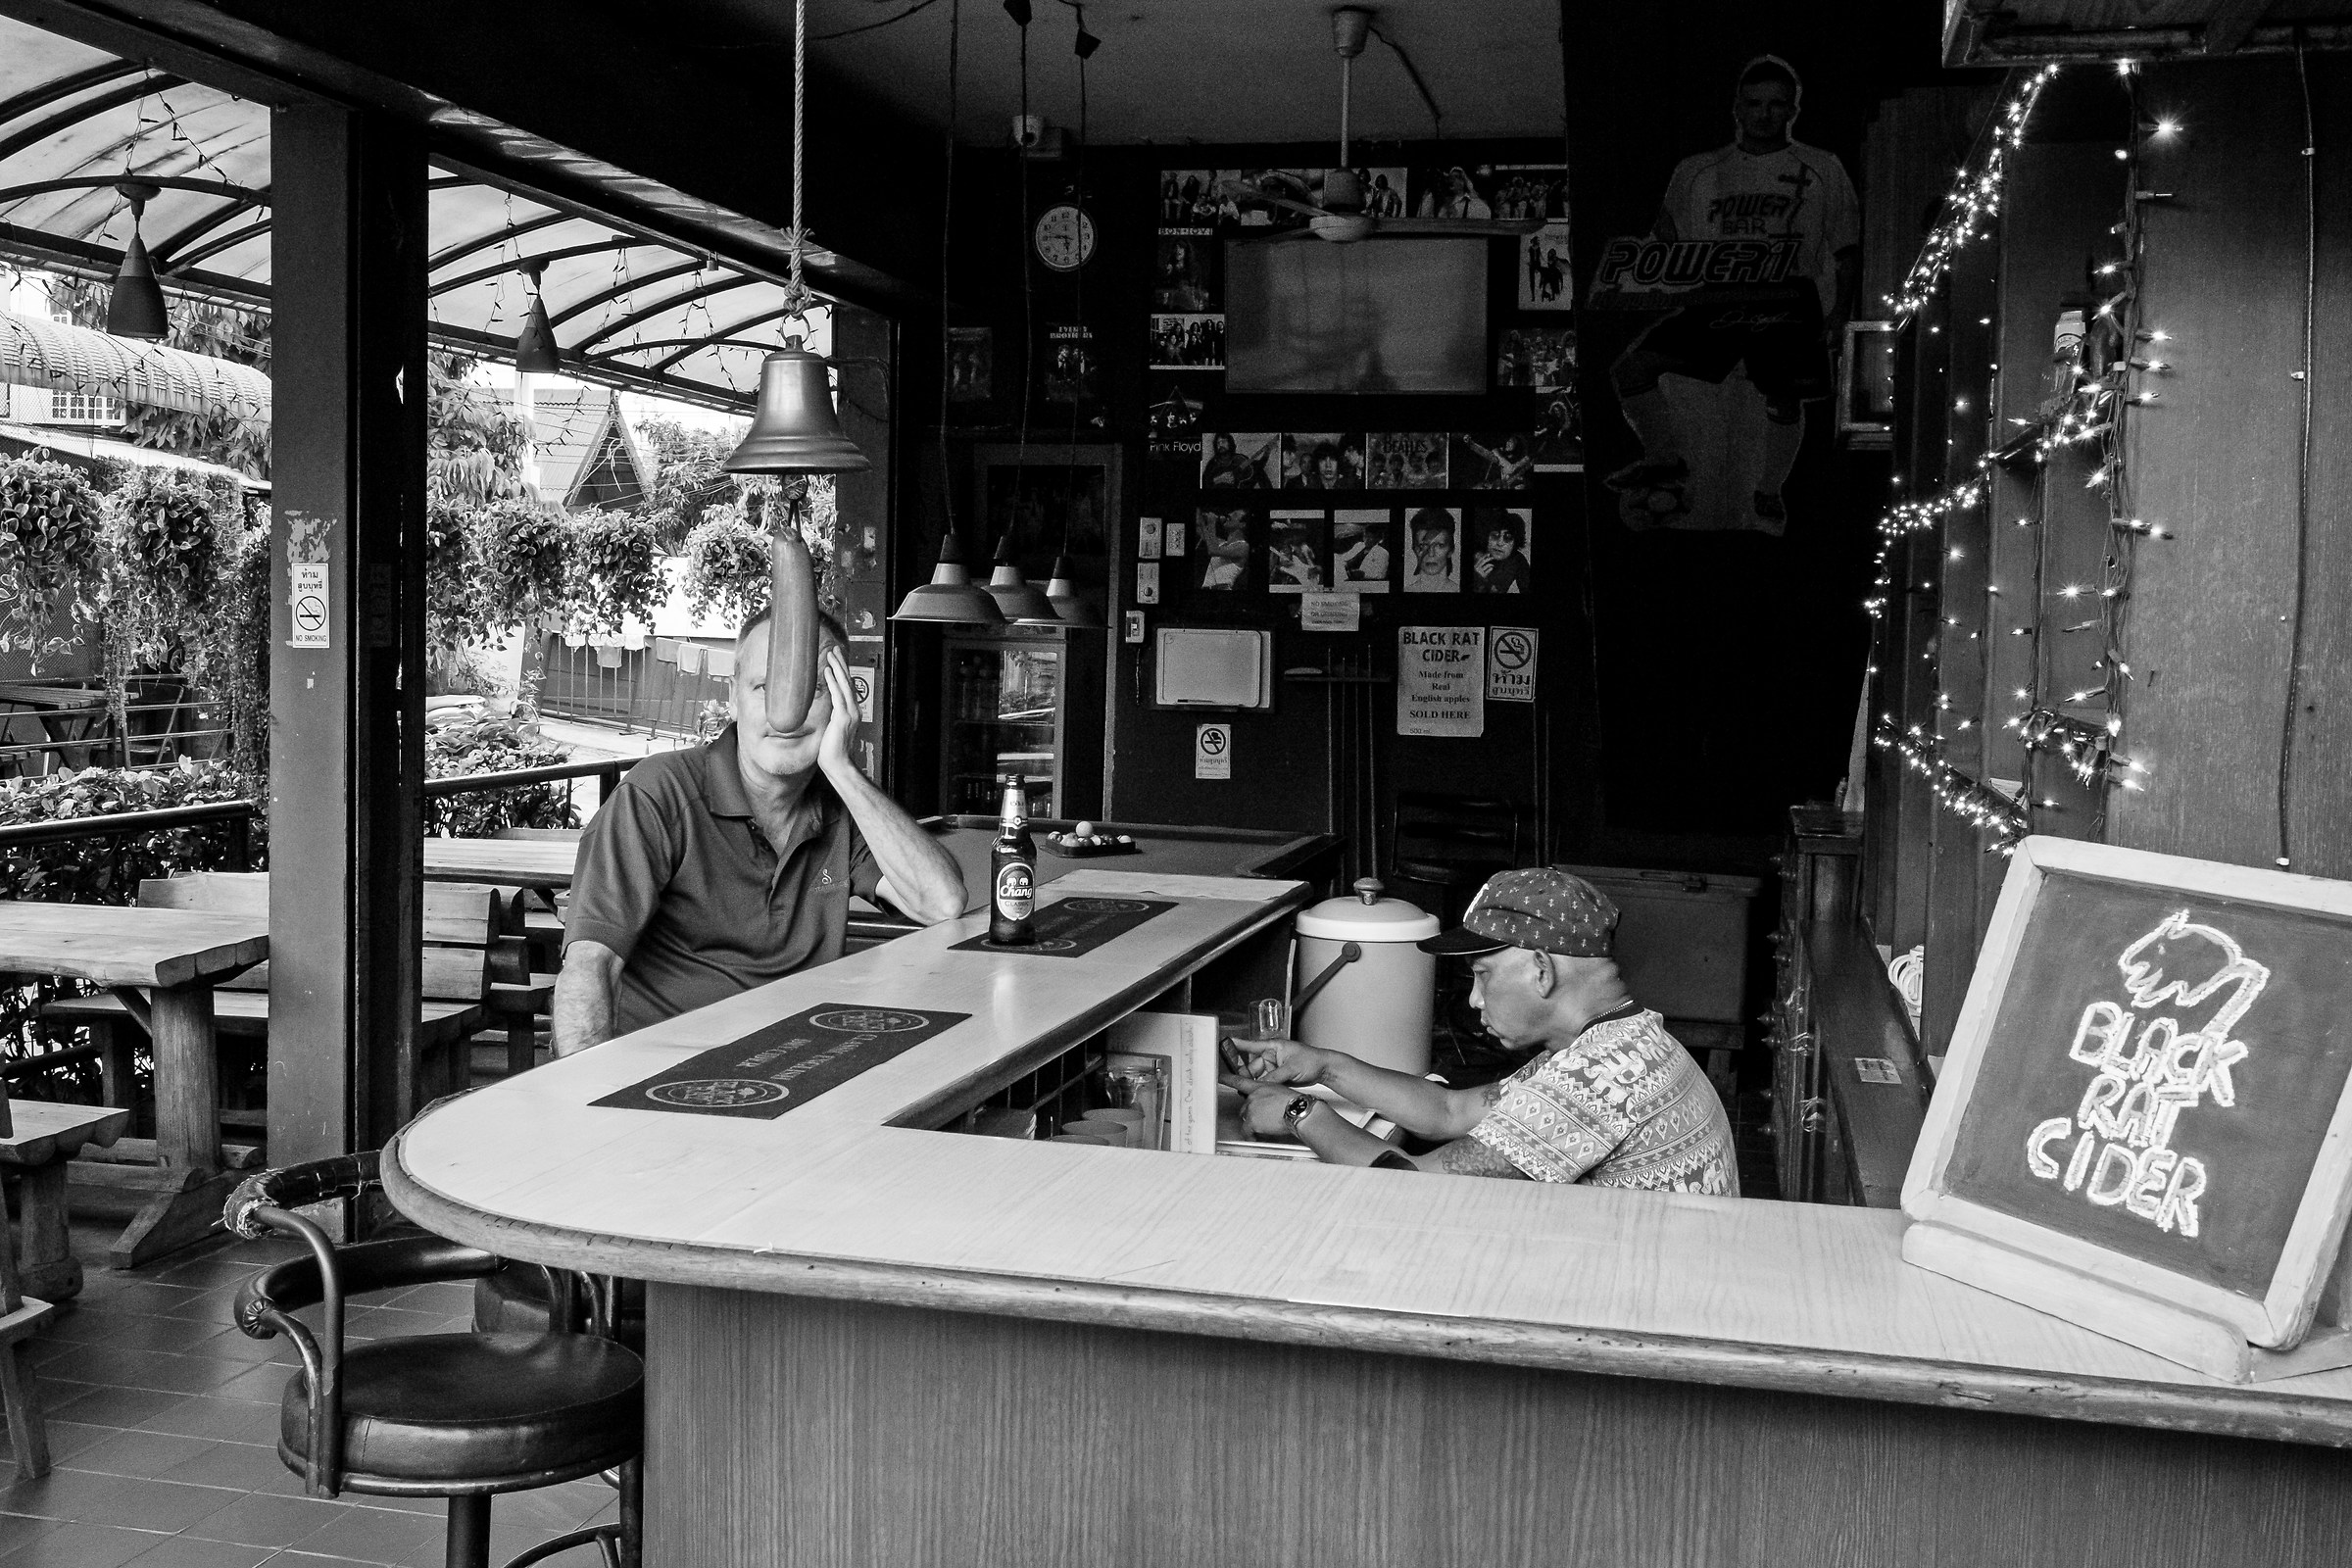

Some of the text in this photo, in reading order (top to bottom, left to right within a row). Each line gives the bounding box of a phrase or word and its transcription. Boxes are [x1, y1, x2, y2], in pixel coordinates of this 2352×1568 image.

[1723, 218, 1766, 234] BAR
[1601, 240, 1802, 284] POWER1
[1150, 441, 1201, 454] Pink Floyd
[1403, 631, 1480, 646] BLACK RAT
[1422, 649, 1461, 662] CIDER
[1419, 670, 1464, 679] Made from
[1492, 669, 1531, 686] ห้าม
[1411, 694, 1471, 705] English apples
[1409, 710, 1471, 719] SOLD HERE
[1000, 884, 1033, 899] Chang
[2069, 1001, 2249, 1107] BLACK
[2076, 1073, 2199, 1149] RAT
[2027, 1117, 2207, 1238] CIDER
